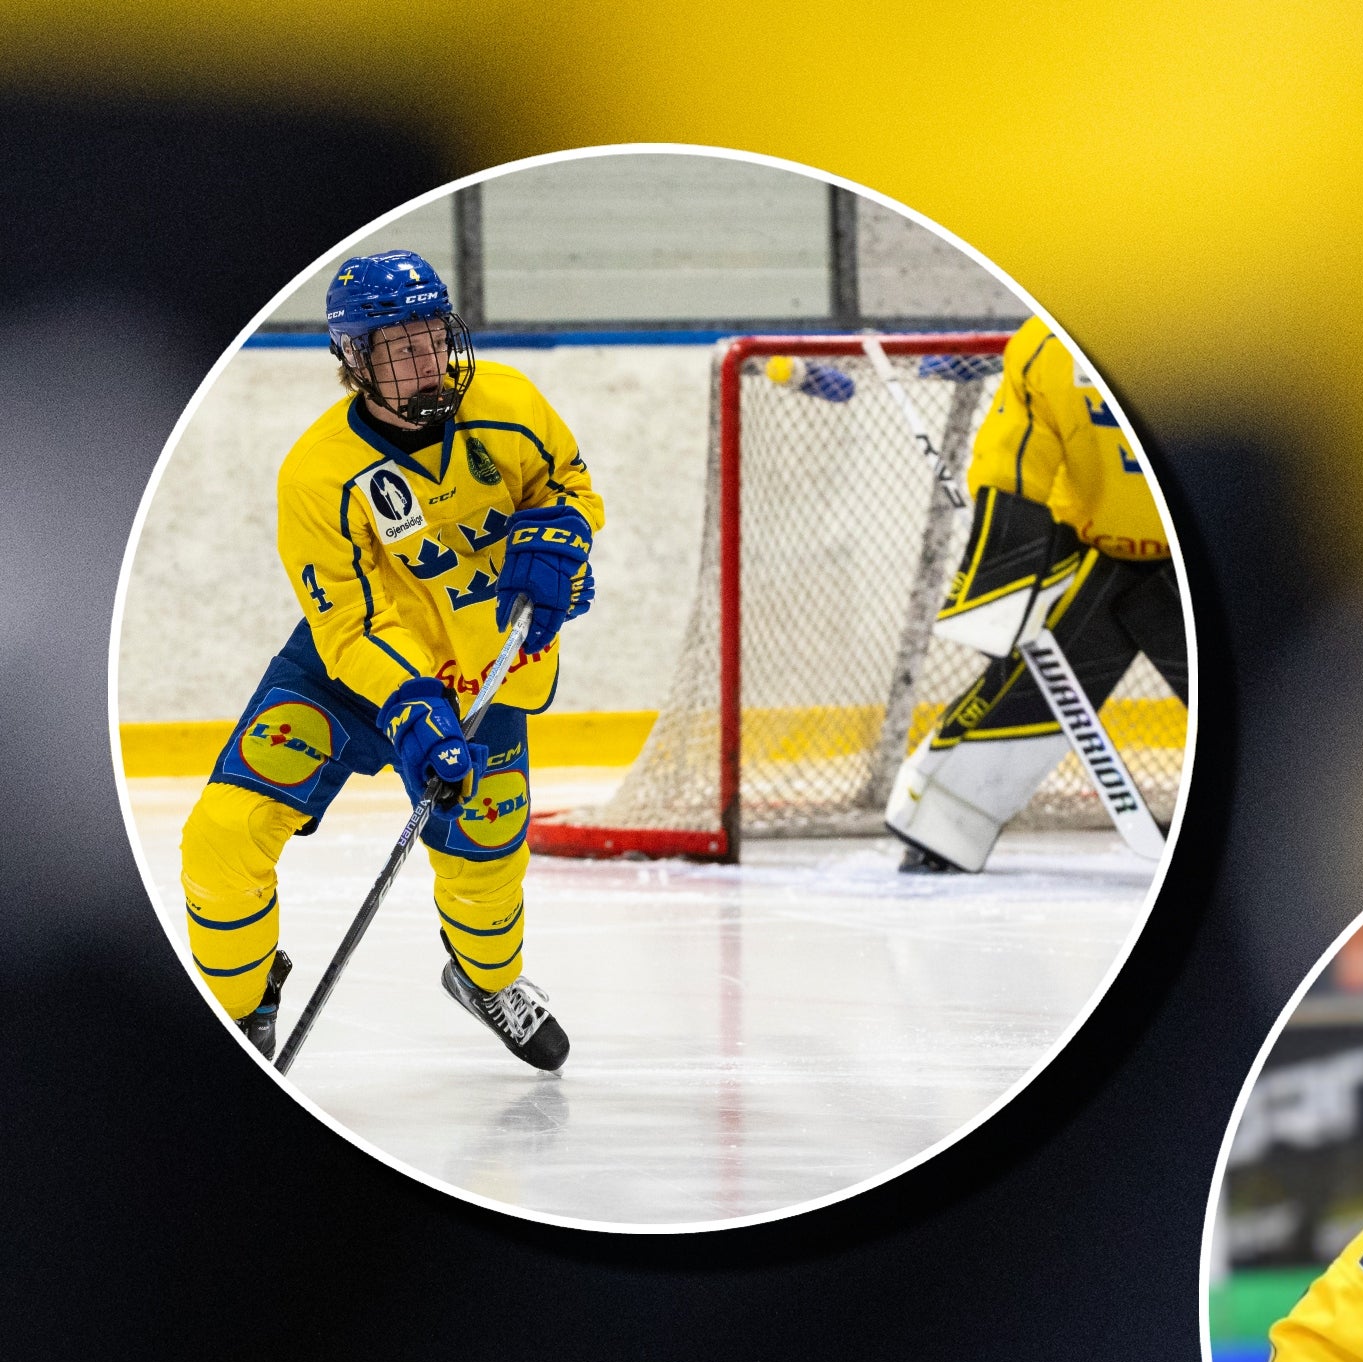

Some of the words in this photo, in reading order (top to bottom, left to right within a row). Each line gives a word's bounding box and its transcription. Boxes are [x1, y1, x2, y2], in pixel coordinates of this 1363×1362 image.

[408, 268, 421, 282] 4
[405, 291, 439, 304] CCM
[327, 309, 345, 320] CCM
[428, 486, 457, 505] CCM
[511, 527, 590, 554] CCM
[301, 562, 333, 614] 4
[1030, 648, 1138, 815] WARRIOR
[487, 742, 521, 767] CM
[491, 904, 520, 927] CCM
